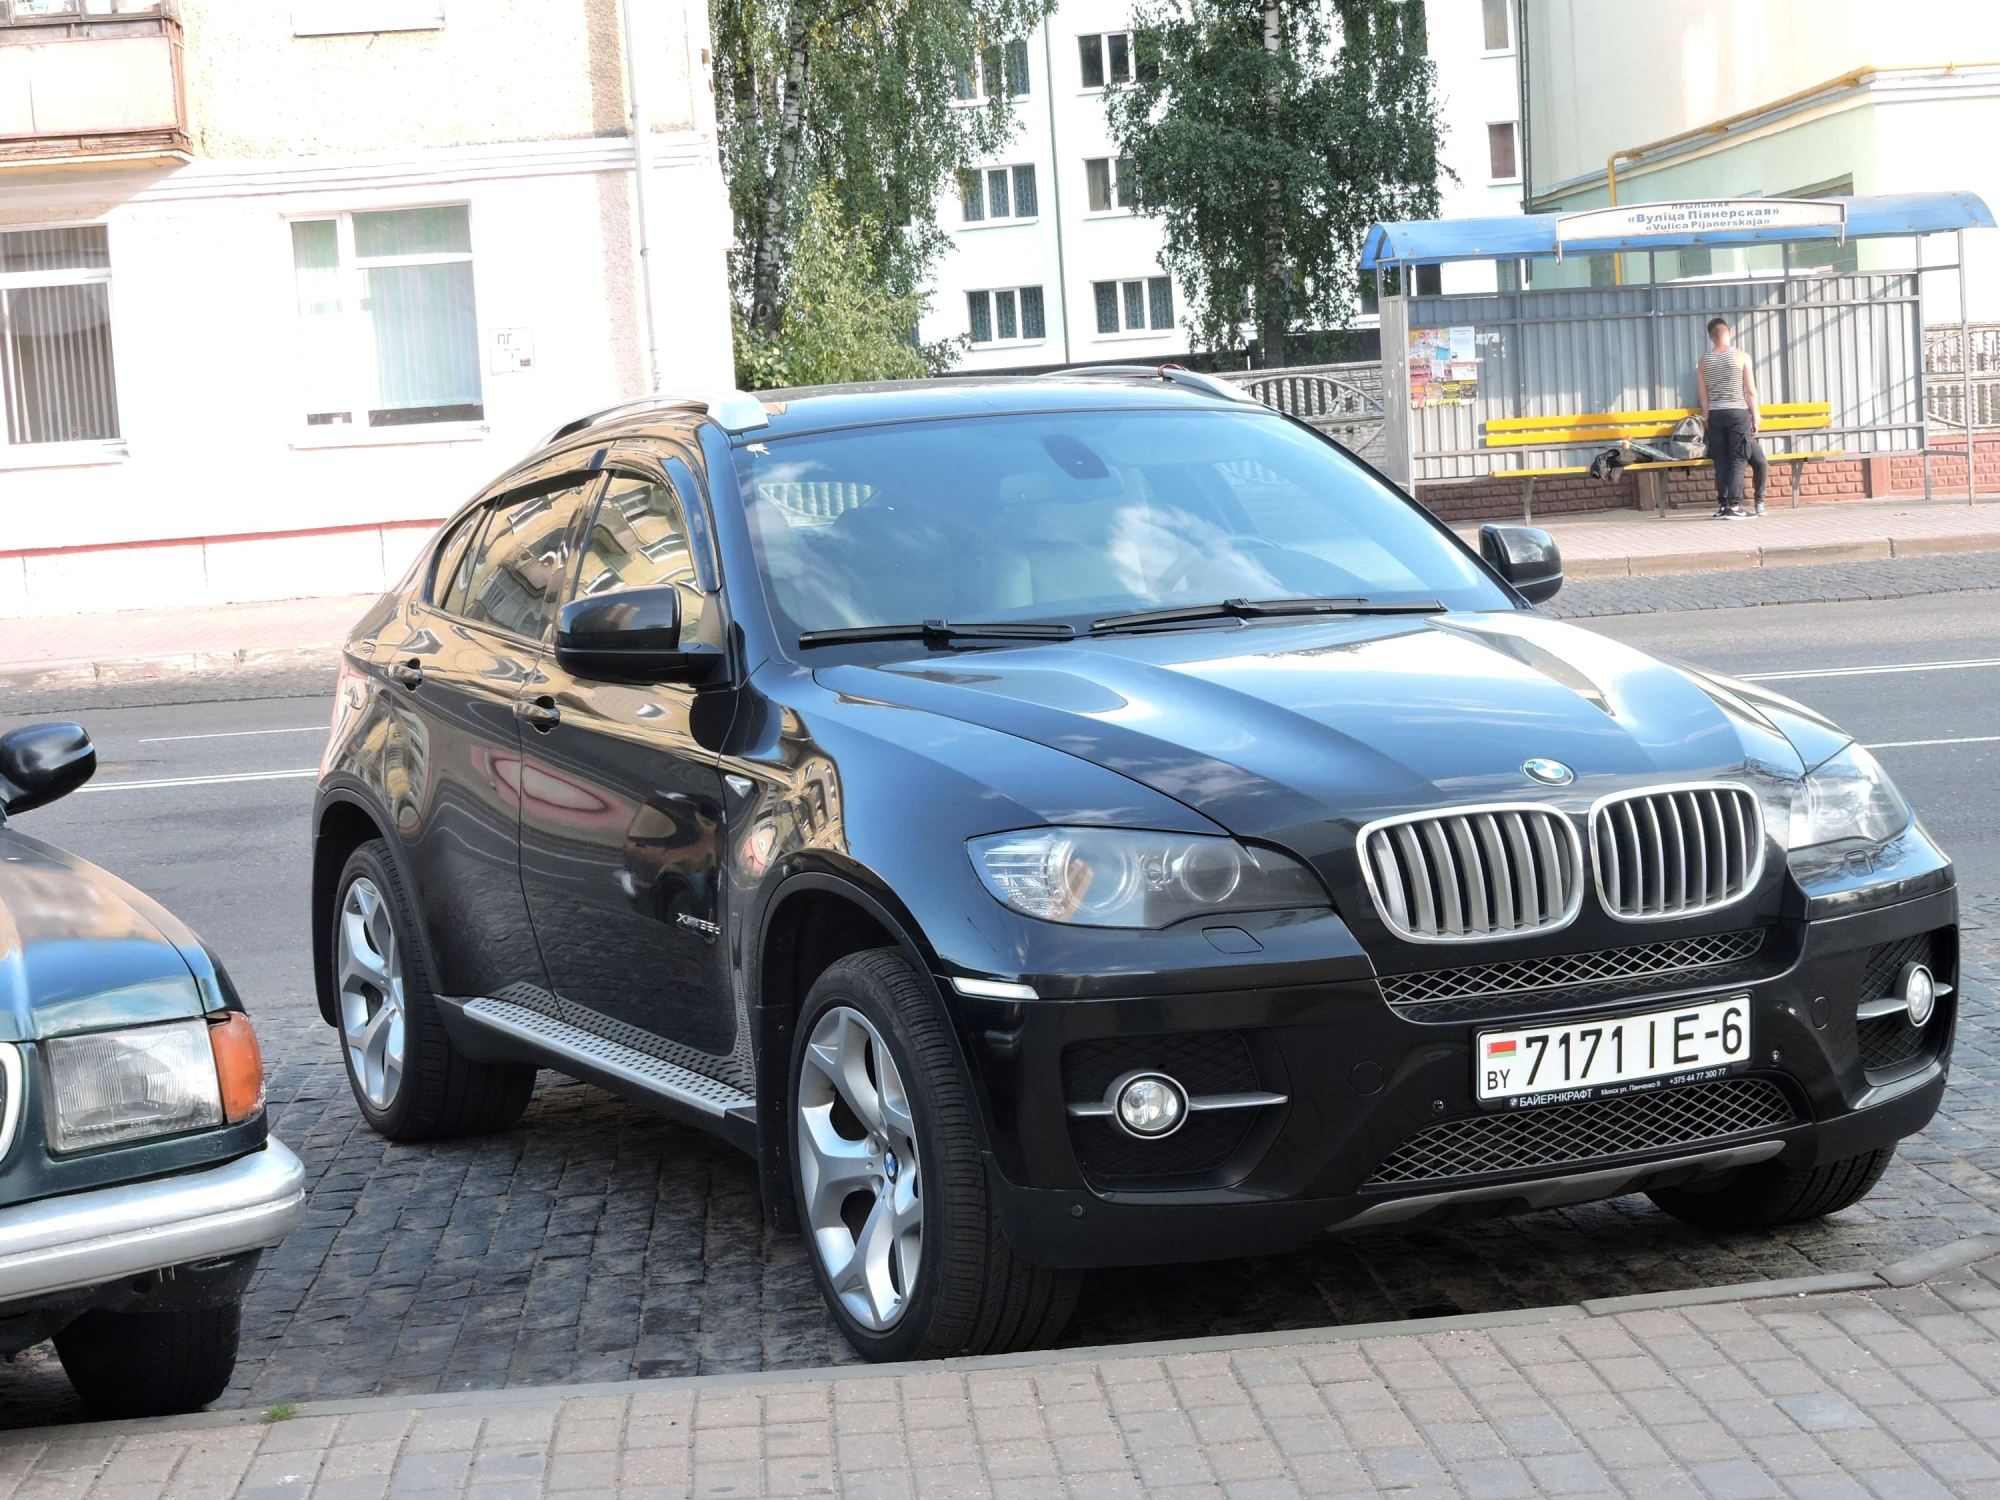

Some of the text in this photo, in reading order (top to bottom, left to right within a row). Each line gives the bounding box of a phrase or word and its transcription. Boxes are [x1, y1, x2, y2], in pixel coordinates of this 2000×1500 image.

[1526, 1007, 1742, 1086] 7171 IE-6
[1487, 1069, 1511, 1090] BY
[1519, 1089, 1594, 1107] БАЙЕРНКРАФТ
[1669, 1075, 1686, 1085] +375
[1686, 1073, 1695, 1082] 44
[1696, 1071, 1704, 1080] 77
[1705, 1069, 1717, 1079] 300
[1718, 1067, 1727, 1076] 77
